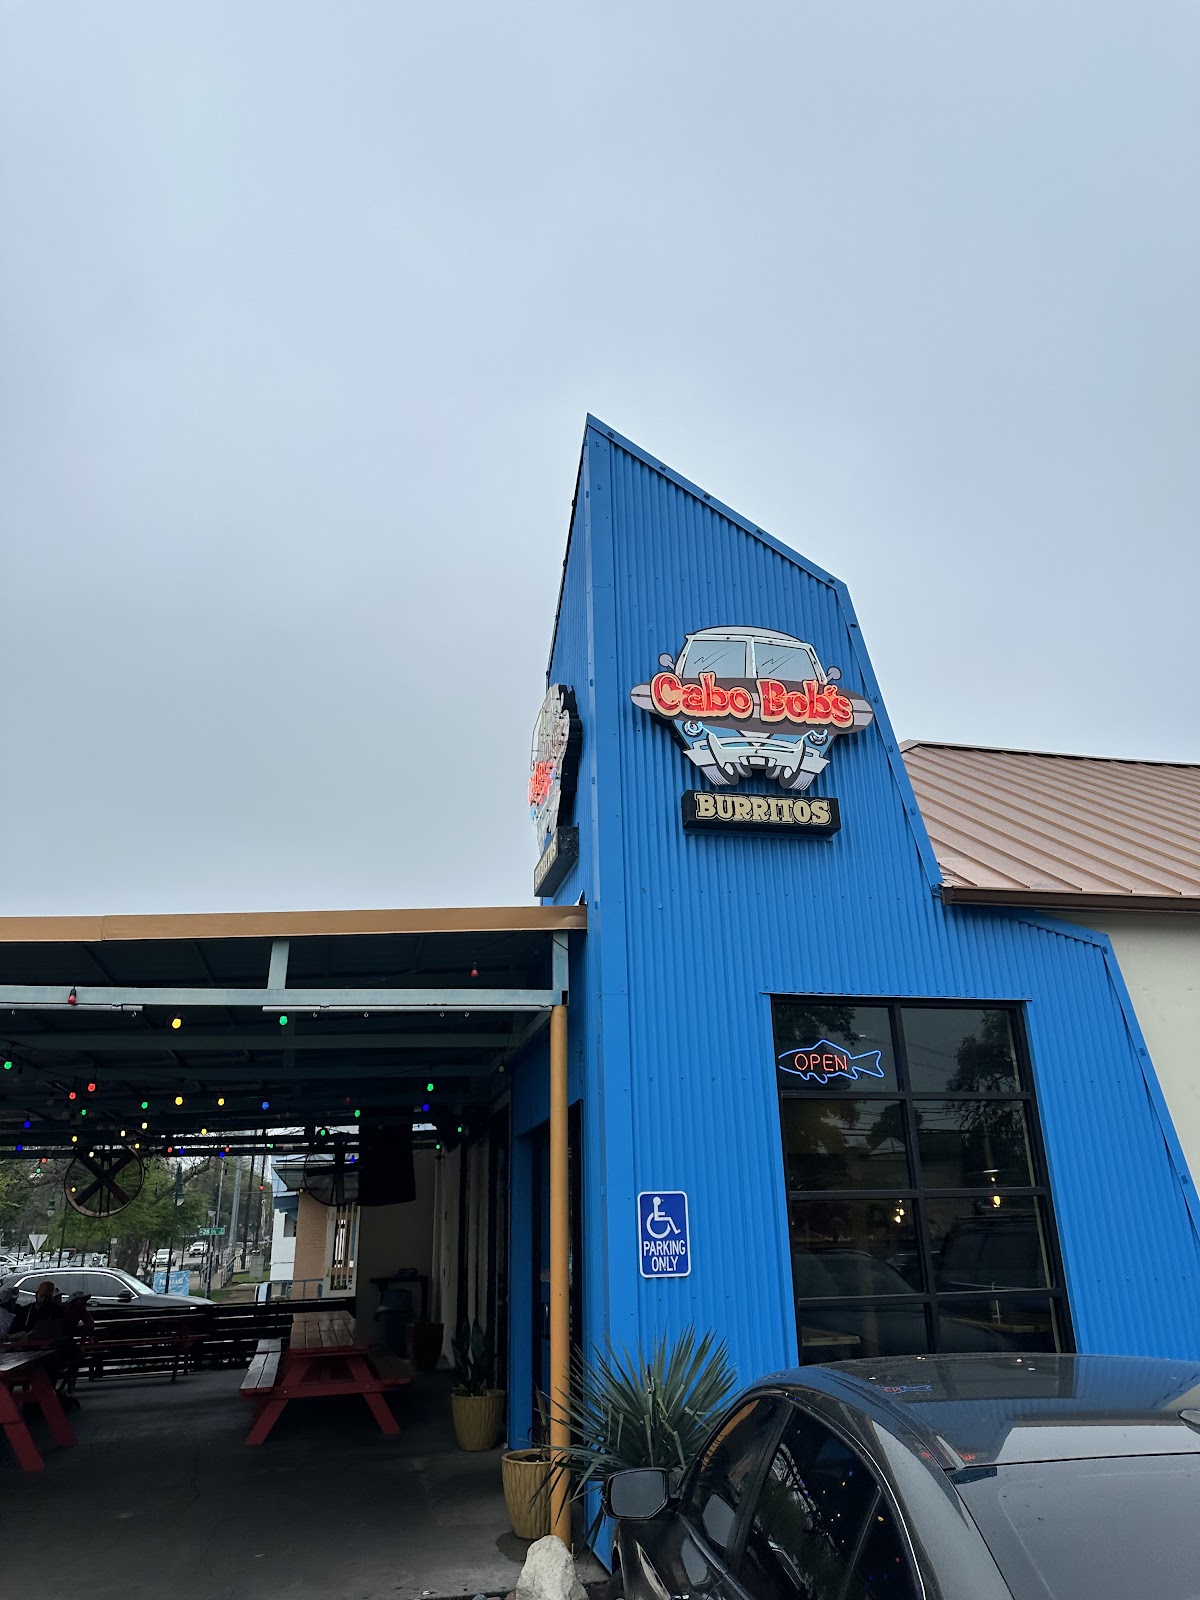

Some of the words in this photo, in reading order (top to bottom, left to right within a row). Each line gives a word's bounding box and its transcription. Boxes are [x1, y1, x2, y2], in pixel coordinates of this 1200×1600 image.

[651, 672, 753, 718] Cabo
[757, 679, 854, 727] Bob's
[695, 792, 832, 825] BURRITOS
[794, 1053, 848, 1071] OPEN
[643, 1240, 686, 1256] PARKING
[651, 1256, 679, 1272] ONLY
